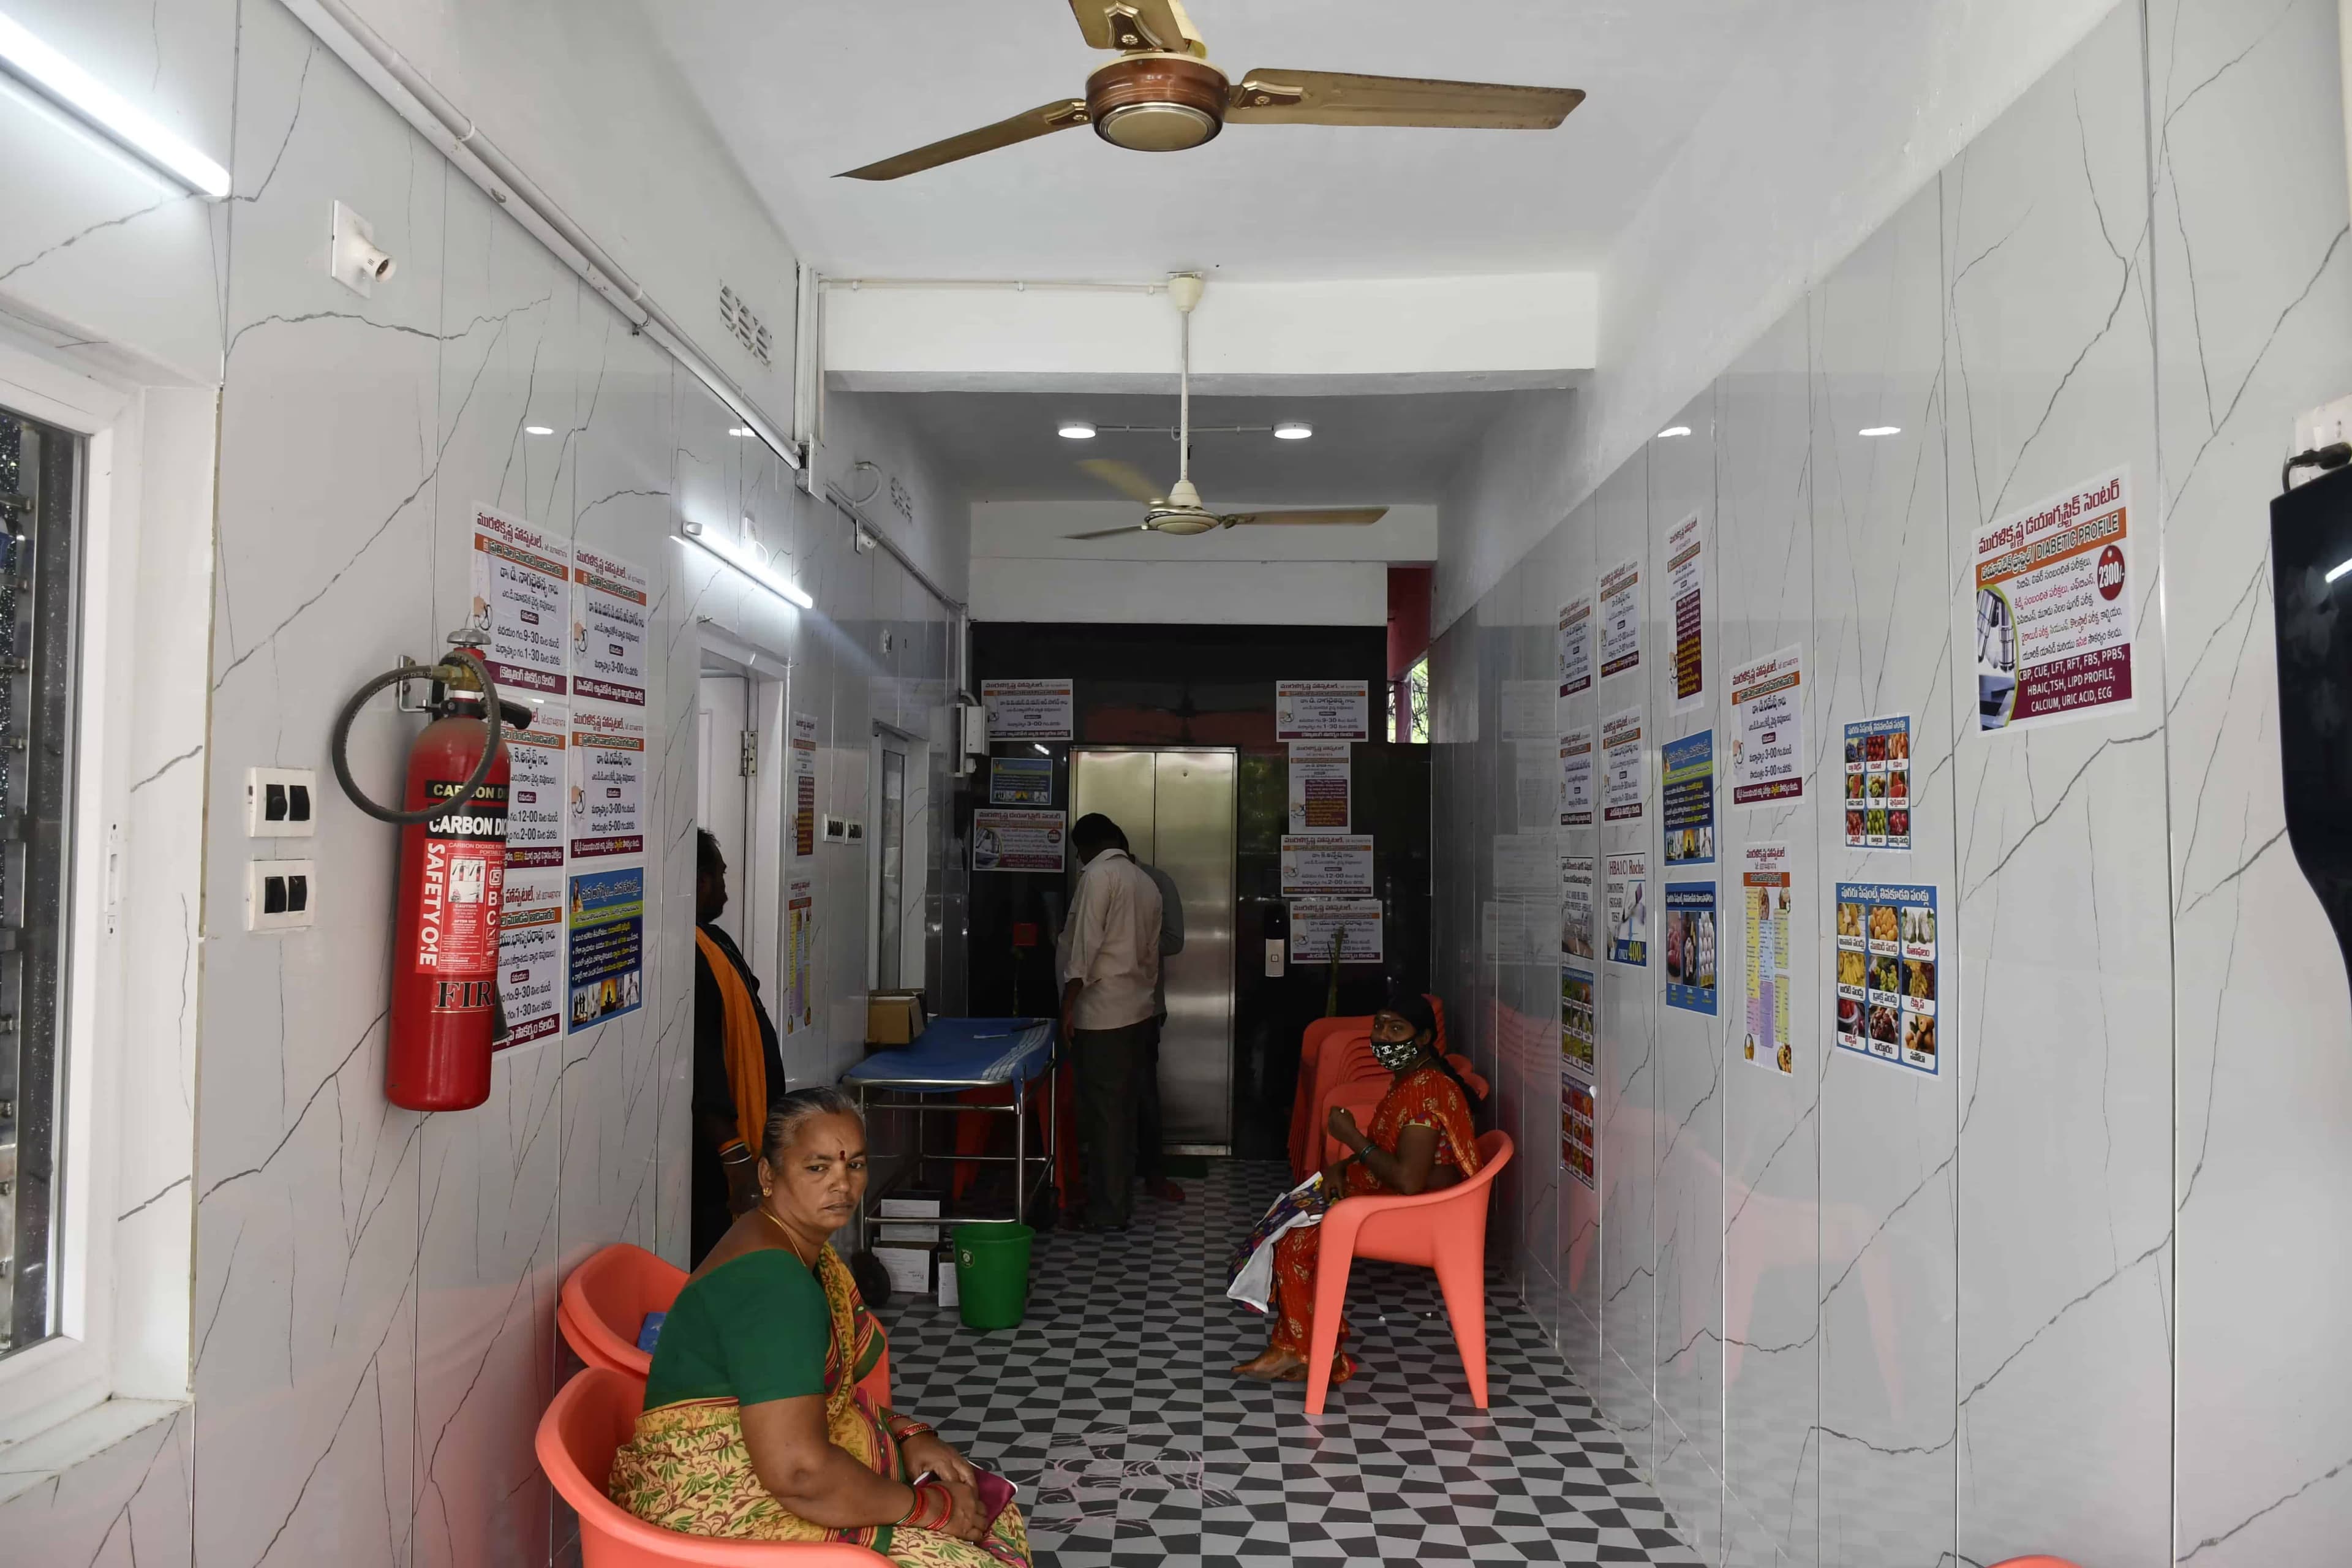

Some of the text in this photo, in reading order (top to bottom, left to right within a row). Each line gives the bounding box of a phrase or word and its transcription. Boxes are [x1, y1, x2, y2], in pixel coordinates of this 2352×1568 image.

[1978, 522, 2024, 554] మురళికృష్ణ
[2083, 479, 2119, 511] సెంటర్
[2037, 530, 2077, 560] DIABETIC
[2078, 513, 2119, 545] PROFILE
[2098, 559, 2125, 589] 2300/-
[611, 661, 623, 673] 3-00
[2019, 646, 2124, 682] CBP, CUE, LFT, RFT, FBS, PPBS,
[2068, 668, 2115, 688] LIPD PROFILE,
[2031, 685, 2111, 712] CALCIUM, URIC ACID, ECG
[1765, 747, 1776, 759] 3-00
[1765, 765, 1776, 776] 5-00
[432, 784, 494, 799] CARON
[609, 803, 620, 813] 3-00
[429, 815, 493, 835] CARBON
[608, 820, 620, 831] 5-00
[1609, 861, 1628, 878] (HBA1C)
[1629, 860, 1644, 875] Roche
[488, 891, 497, 906] B
[486, 910, 496, 925] C
[435, 981, 496, 1009] FIR
